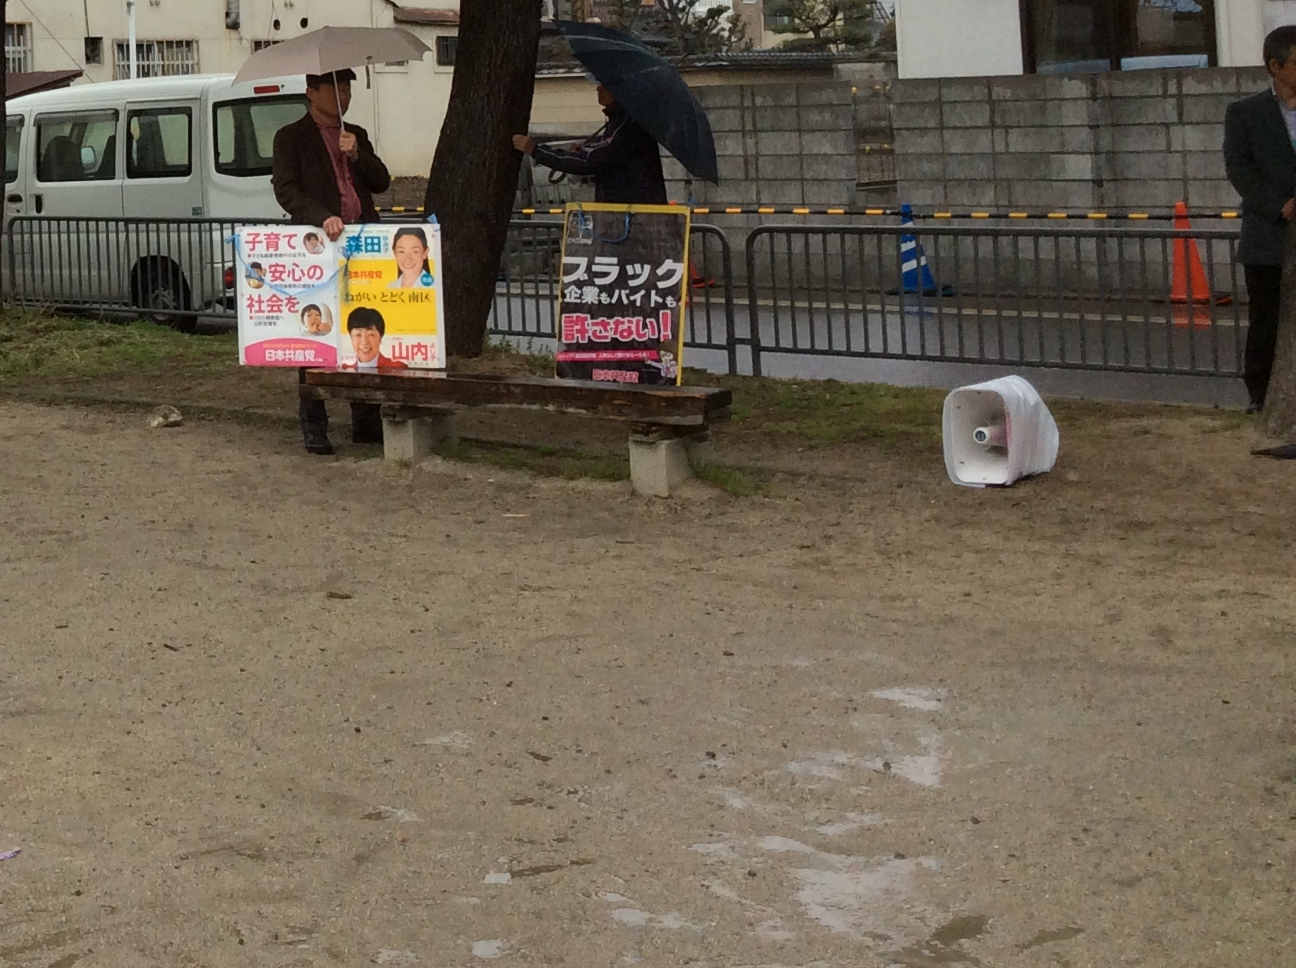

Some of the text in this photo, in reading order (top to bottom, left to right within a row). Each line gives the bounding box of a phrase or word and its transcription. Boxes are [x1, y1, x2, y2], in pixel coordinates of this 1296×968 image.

[245, 232, 298, 252] 子育て
[346, 235, 381, 253] 森田
[268, 262, 324, 282] 安心の
[562, 257, 684, 288] ブラック
[247, 294, 300, 314] 社会を
[564, 285, 677, 307] 企業もバイトも
[562, 310, 672, 343] 許さない！
[265, 349, 315, 362] 日本共産党
[391, 341, 429, 361] 山内
